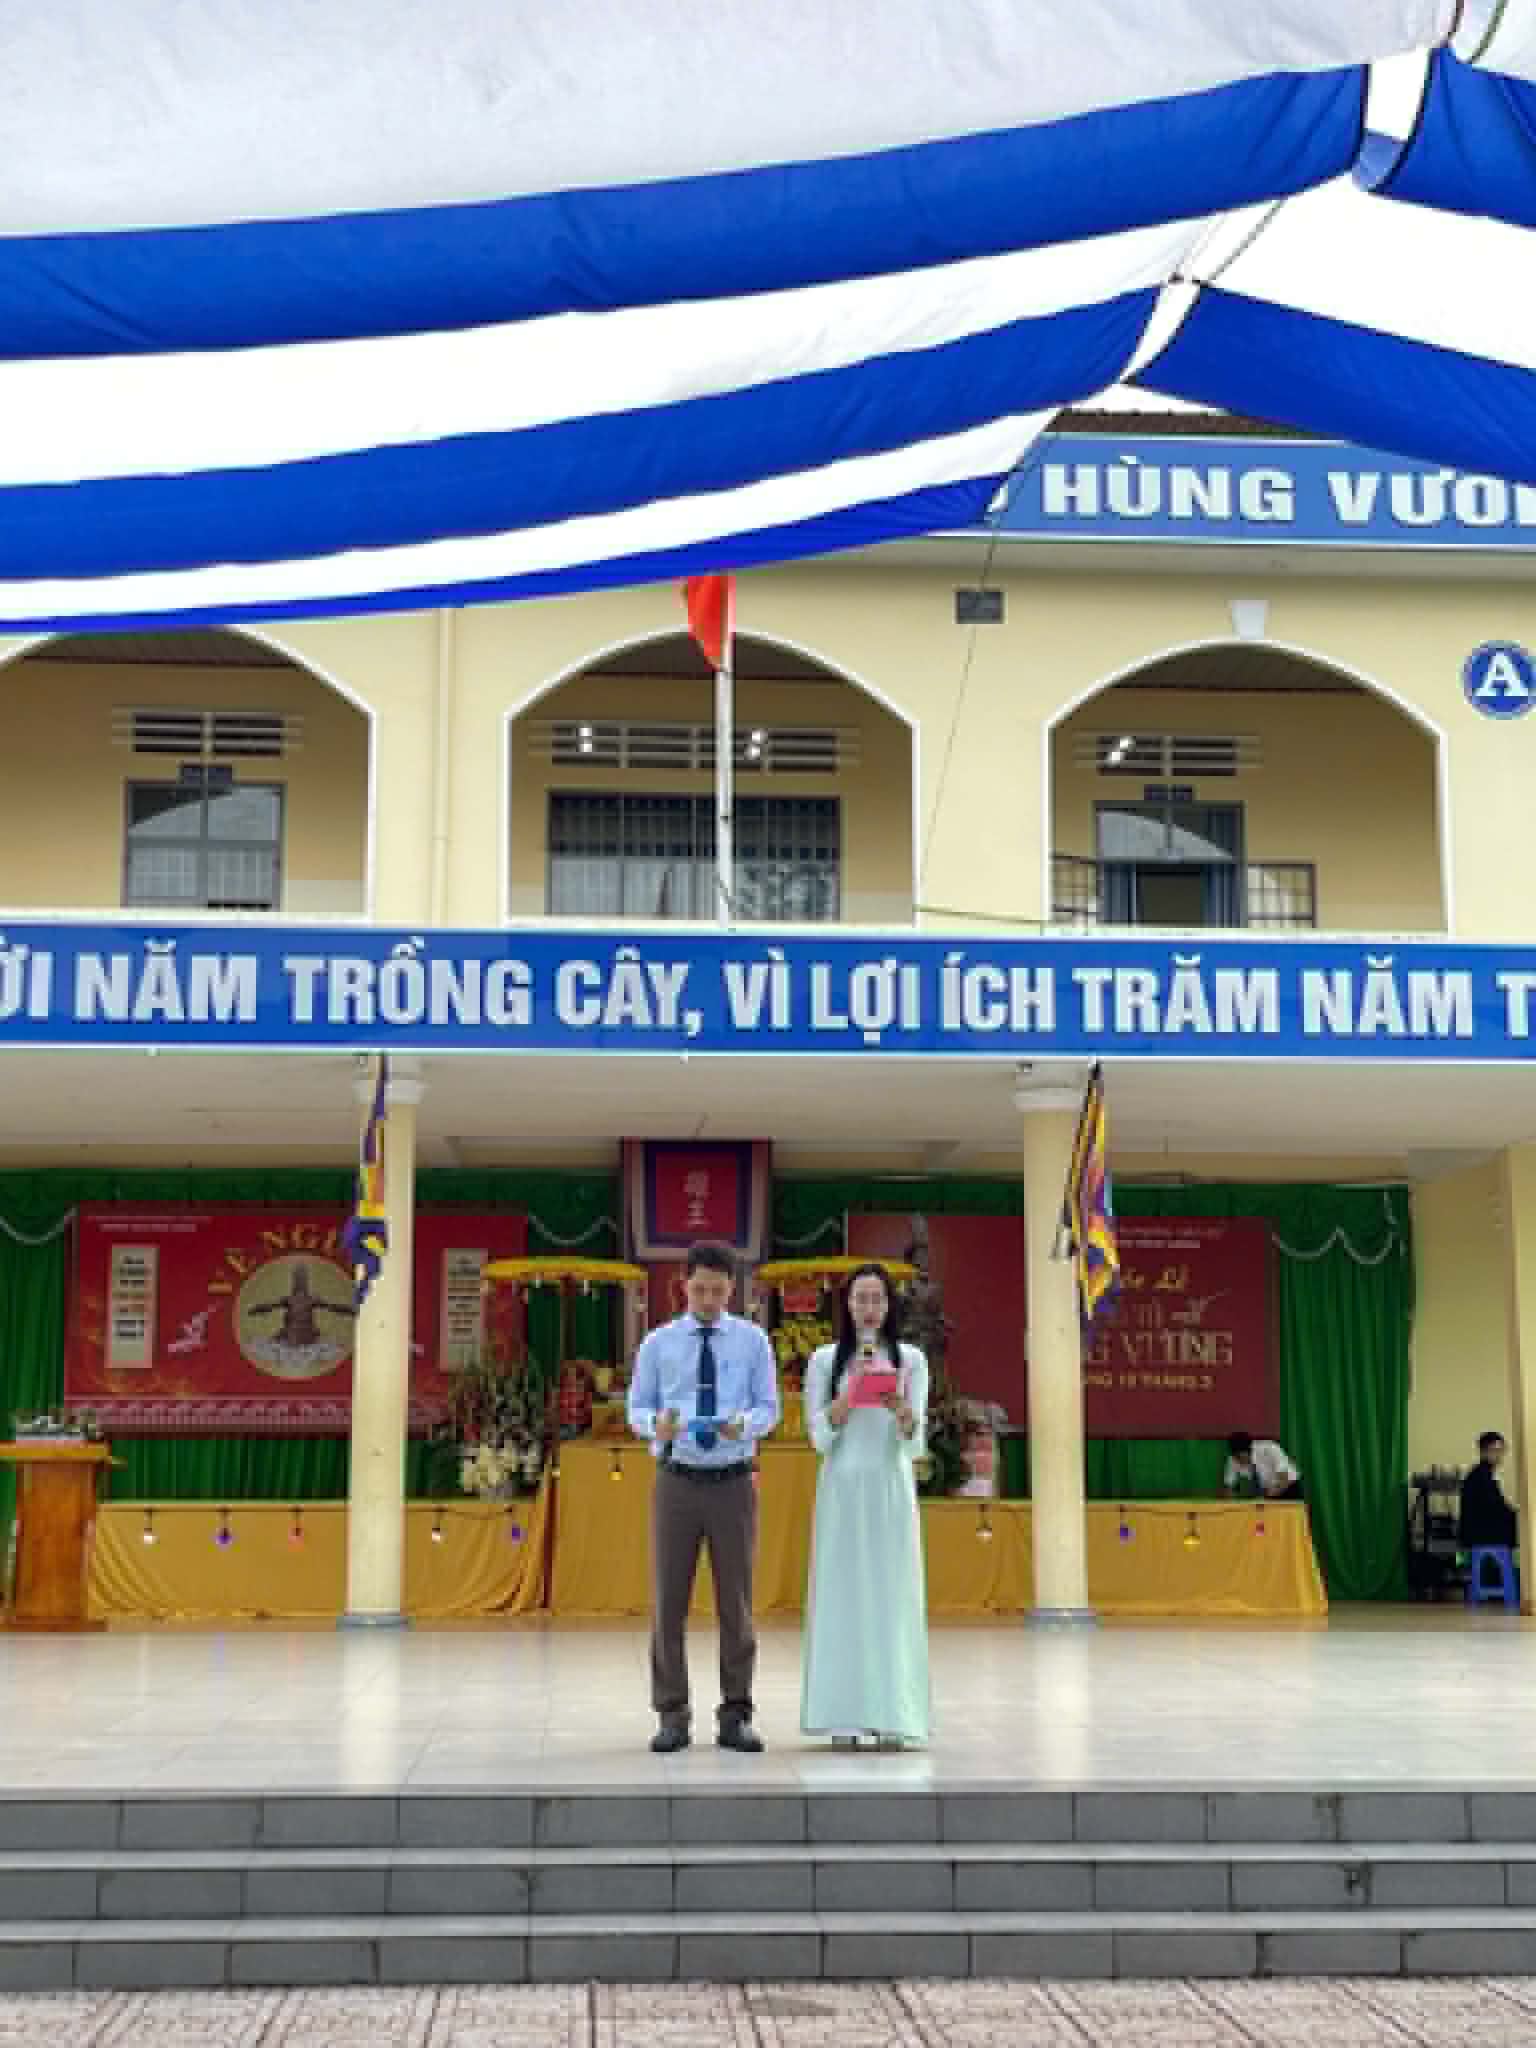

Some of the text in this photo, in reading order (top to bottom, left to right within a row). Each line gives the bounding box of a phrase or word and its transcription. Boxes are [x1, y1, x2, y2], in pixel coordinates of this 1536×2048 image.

[1042, 455, 1295, 521] HÙNG
[1477, 653, 1531, 697] A
[75, 937, 257, 1021] NĂM
[284, 935, 531, 1025] TRỒNG
[557, 946, 703, 1037] CÂY,
[723, 947, 790, 1032] VÌ
[810, 957, 921, 1046] LỢI
[942, 951, 1056, 1034] ÍCH
[1072, 954, 1281, 1035] TRĂM
[1302, 954, 1474, 1037] NĂM
